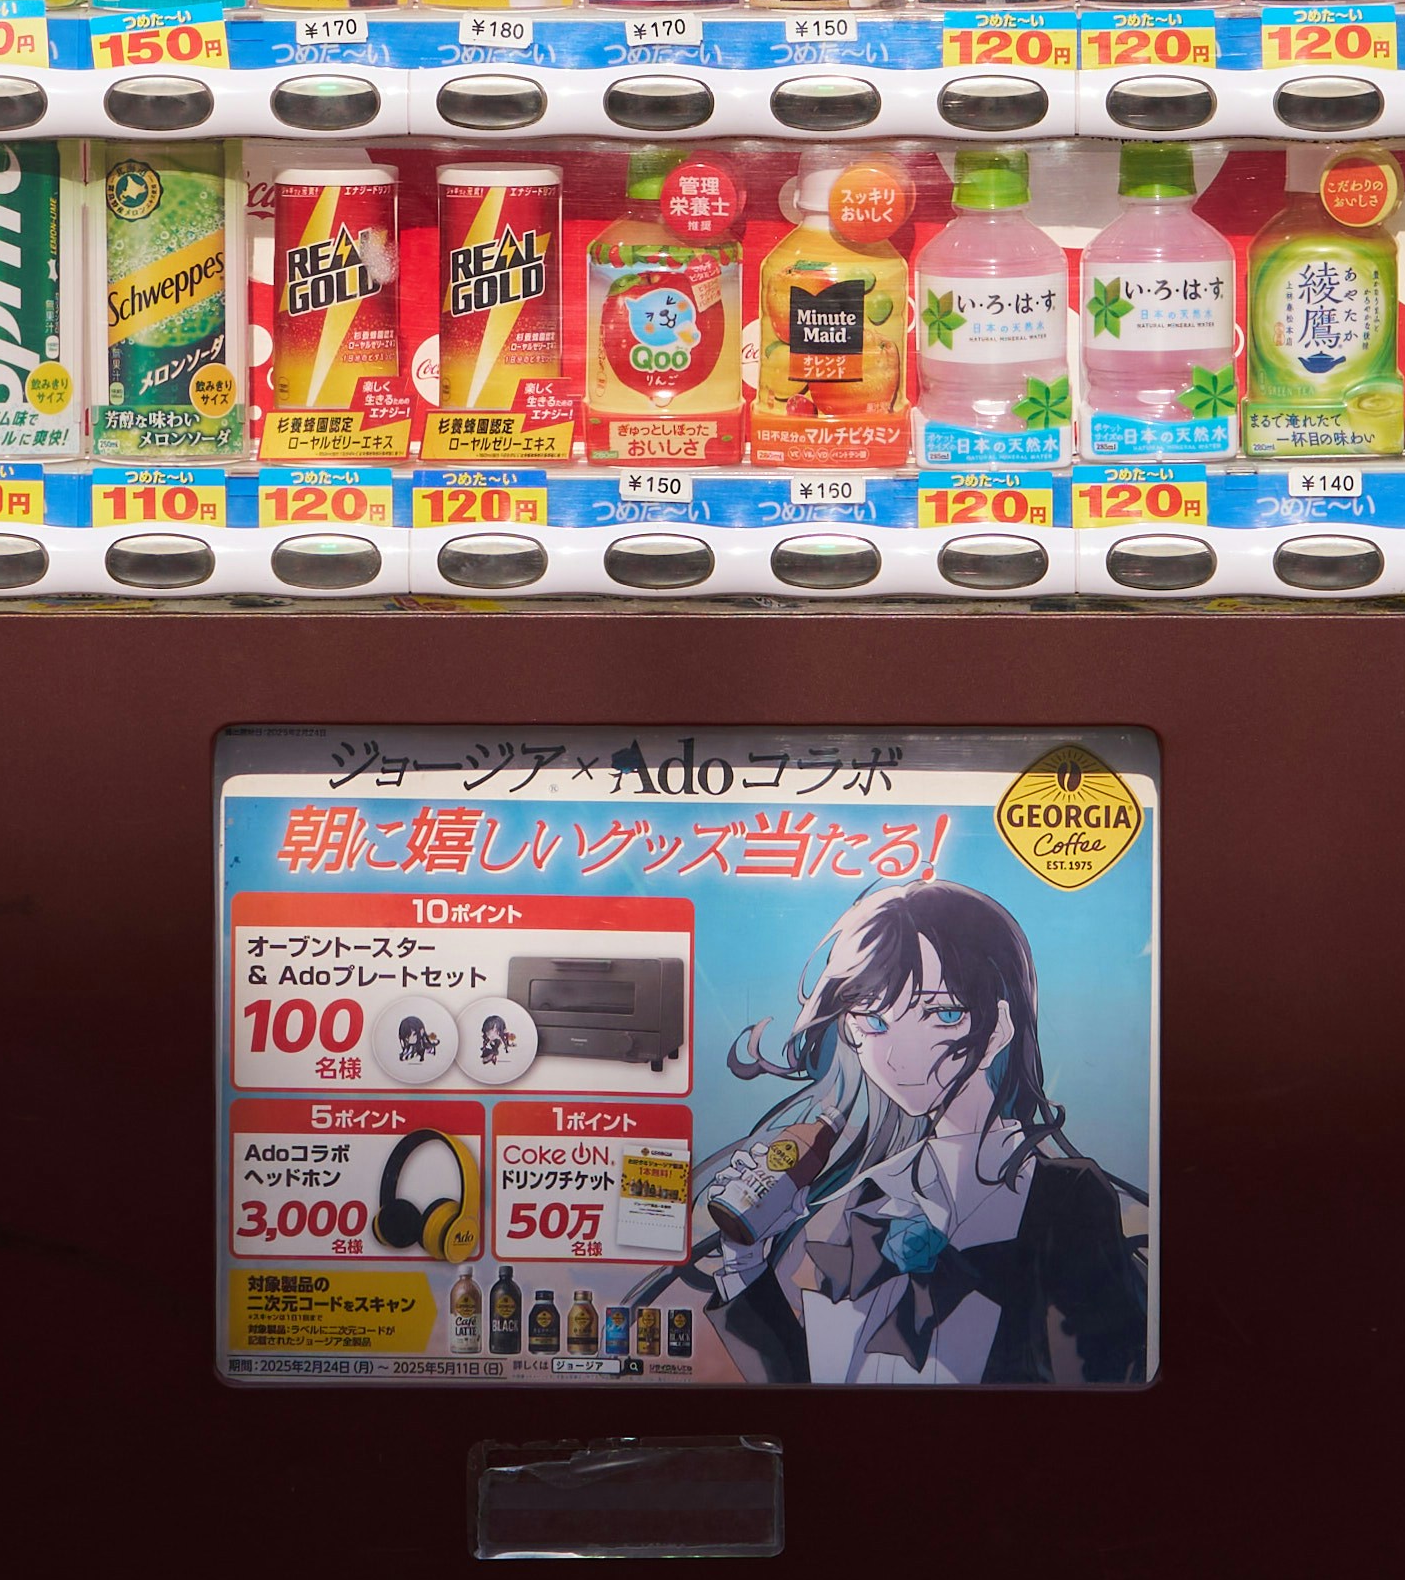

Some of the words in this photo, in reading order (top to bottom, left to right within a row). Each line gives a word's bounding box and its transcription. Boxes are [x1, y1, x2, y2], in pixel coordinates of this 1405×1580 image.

[107, 251, 224, 327] Schweppes
[797, 309, 856, 326] Minute
[804, 327, 846, 343] Maid
[631, 344, 687, 371] Qoo
[1250, 413, 1341, 428] まるで淹れたて
[1007, 803, 1131, 830] GEORGIA
[277, 805, 950, 883] 朝に嬉しいグッズ当たる!
[247, 937, 436, 956] オーブントースター
[248, 966, 267, 986] &
[278, 965, 486, 987] Adoプレートセット
[243, 1000, 363, 1053] 100
[501, 1169, 615, 1190] ドリンクチケット
[237, 1201, 367, 1241] 3,000
[506, 1204, 603, 1240] 50万
[247, 1295, 415, 1314] 二次元コードをスキャン
